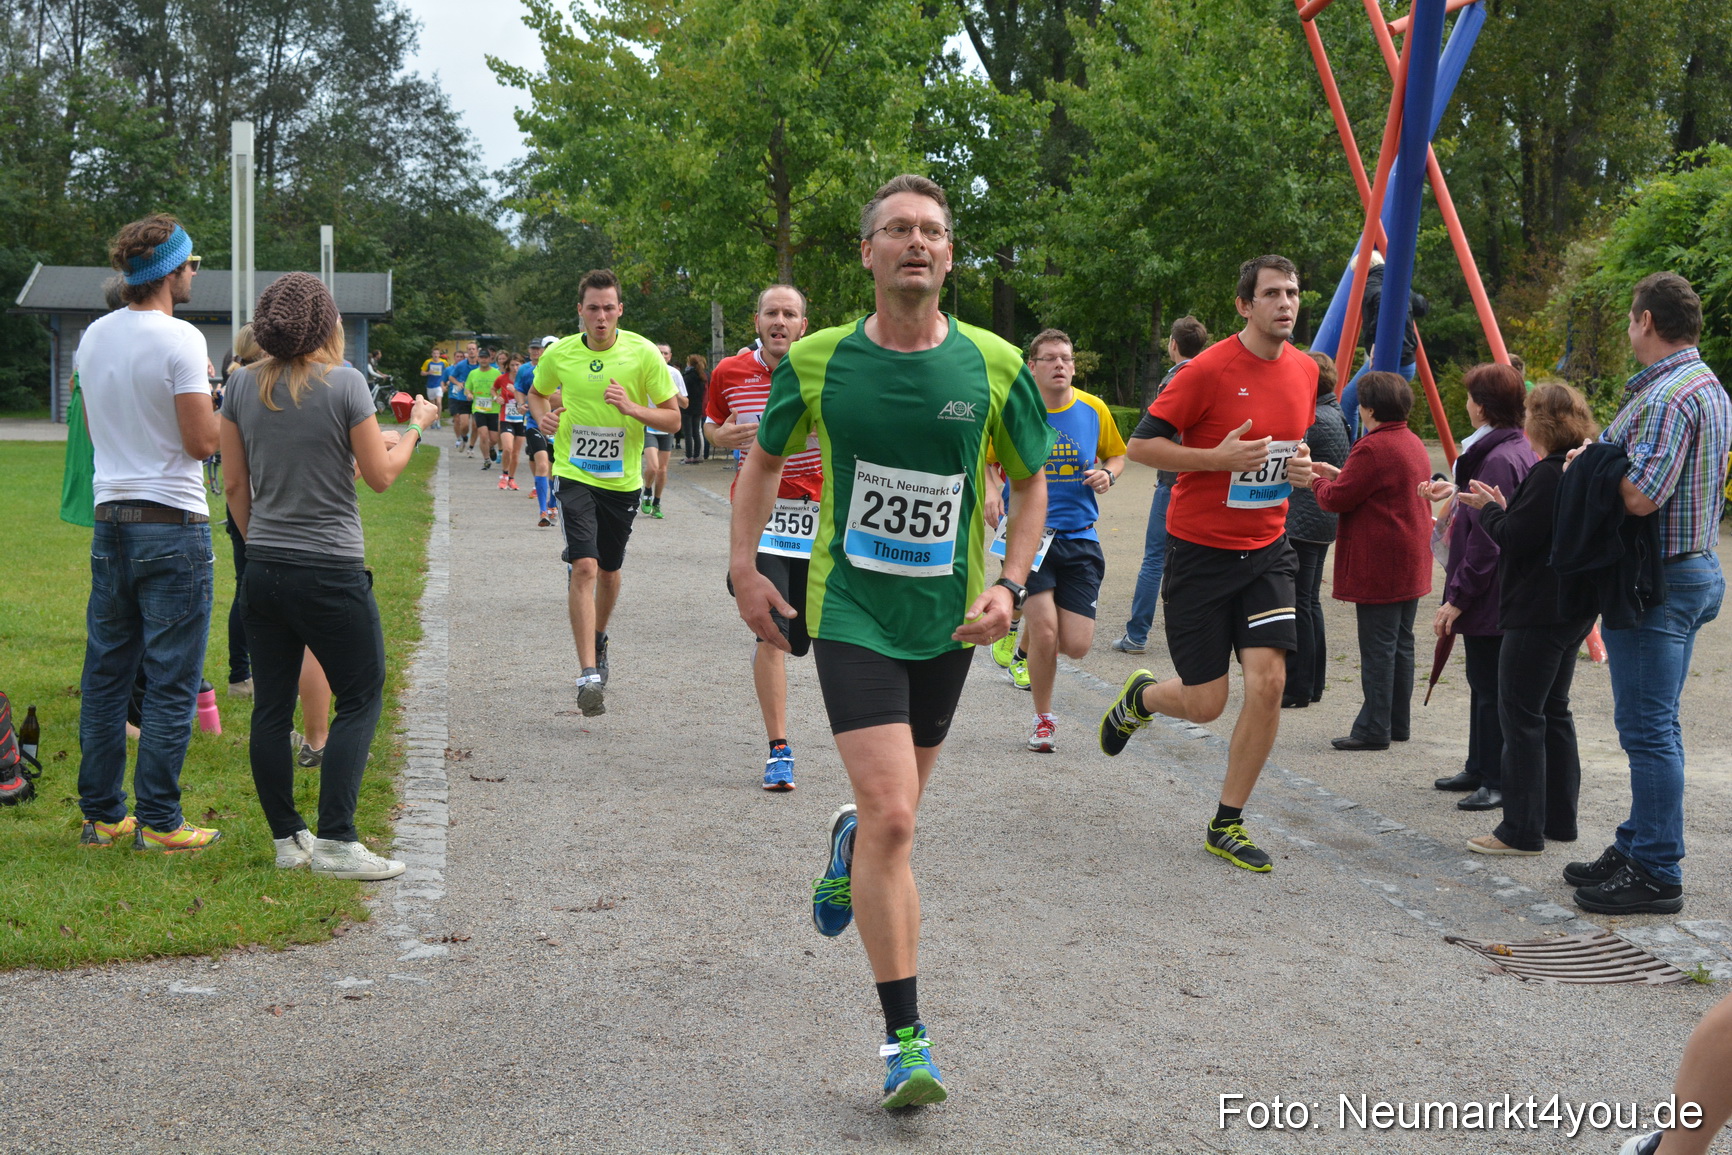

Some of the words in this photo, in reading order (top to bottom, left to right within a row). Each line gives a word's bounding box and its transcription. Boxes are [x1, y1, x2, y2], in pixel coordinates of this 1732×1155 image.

[939, 400, 977, 418] AOK
[572, 428, 590, 436] PARTL
[576, 437, 620, 459] 2225
[581, 461, 611, 471] Dominik
[857, 471, 894, 489] PARTL
[896, 480, 950, 496] Neumarkt
[1249, 488, 1278, 500] Philipp
[779, 504, 810, 512] Neumarkt
[860, 490, 953, 538] 2353
[769, 537, 801, 550] Thomas
[873, 540, 931, 563] Thomas
